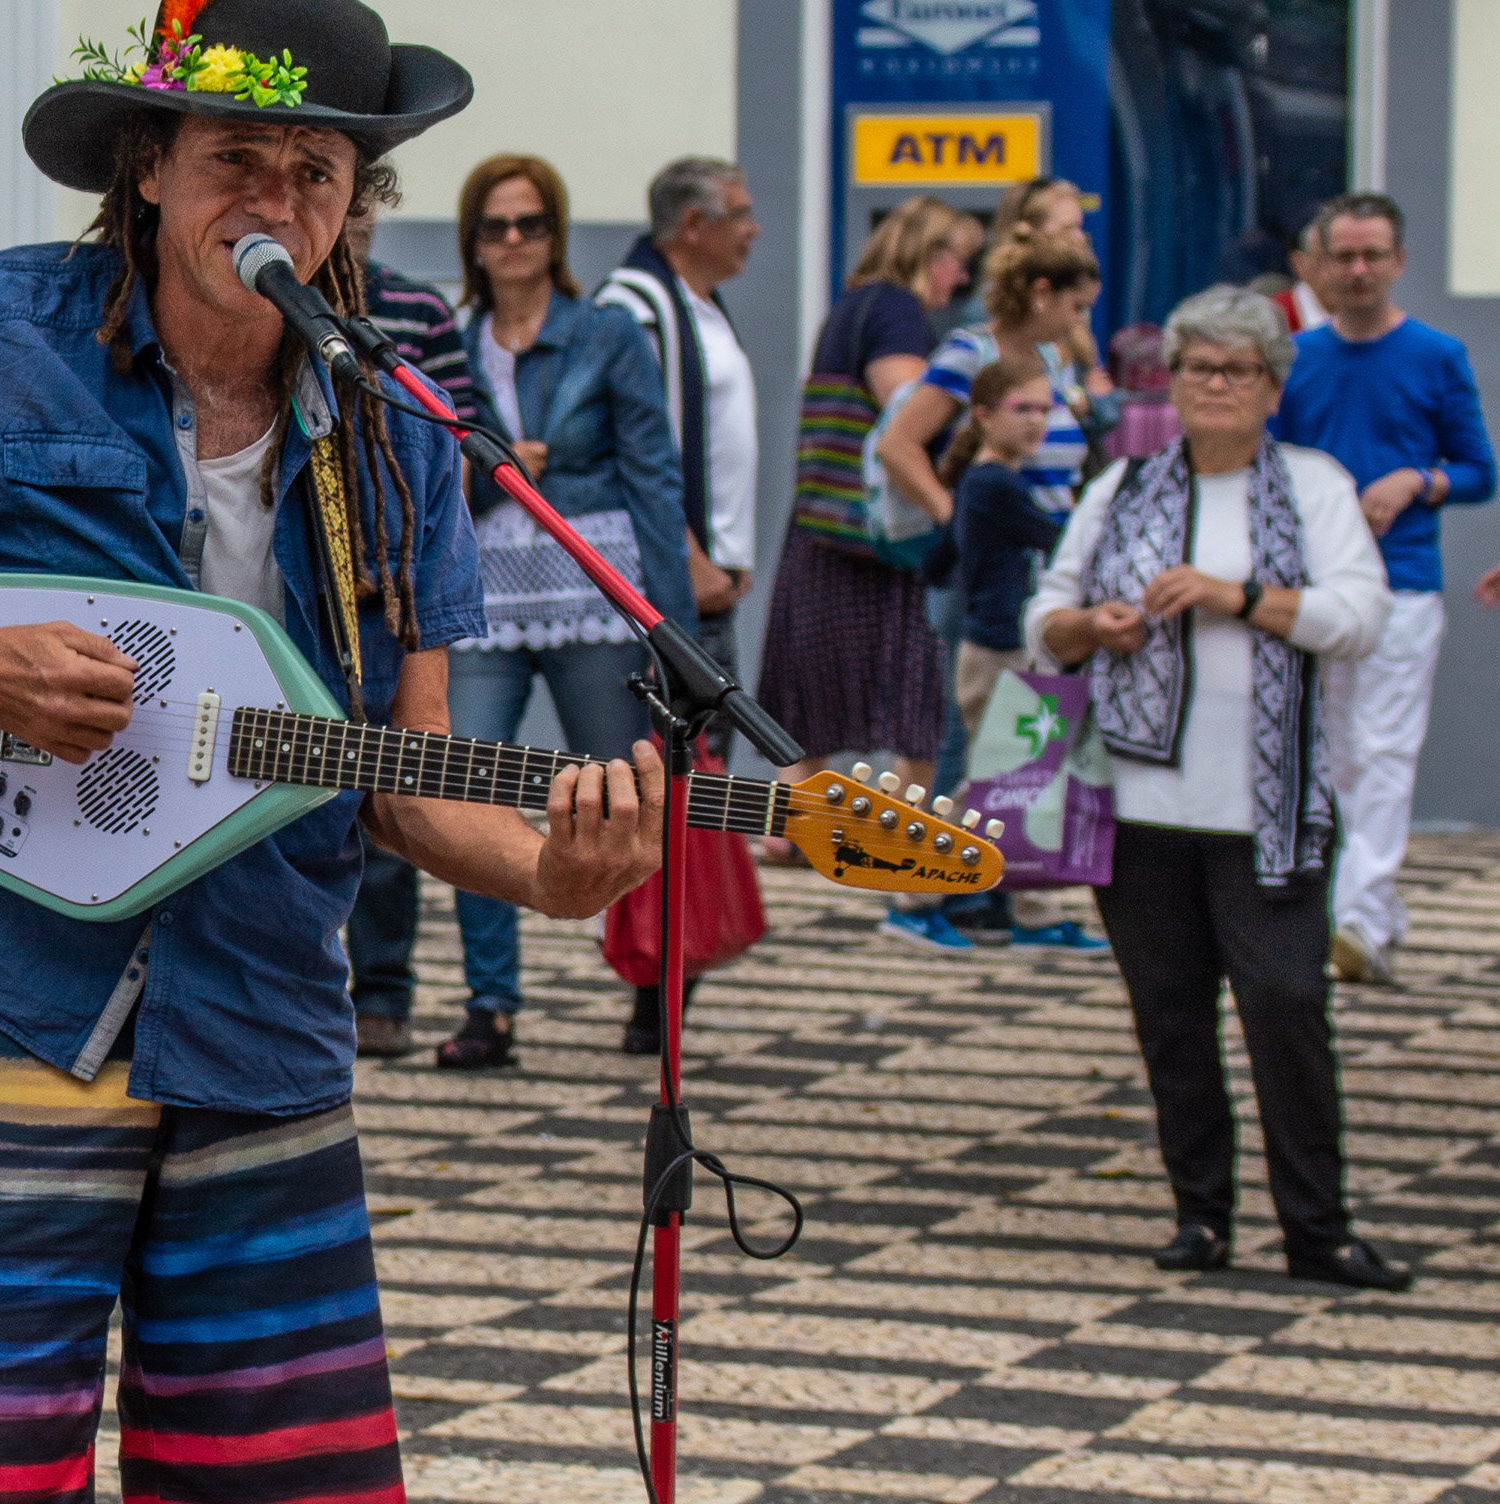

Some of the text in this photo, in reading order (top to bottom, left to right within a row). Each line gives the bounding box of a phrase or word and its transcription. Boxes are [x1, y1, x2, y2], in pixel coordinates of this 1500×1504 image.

[888, 132, 1006, 165] ATM
[911, 866, 983, 884] APACHE
[654, 1324, 673, 1418] Millenium
